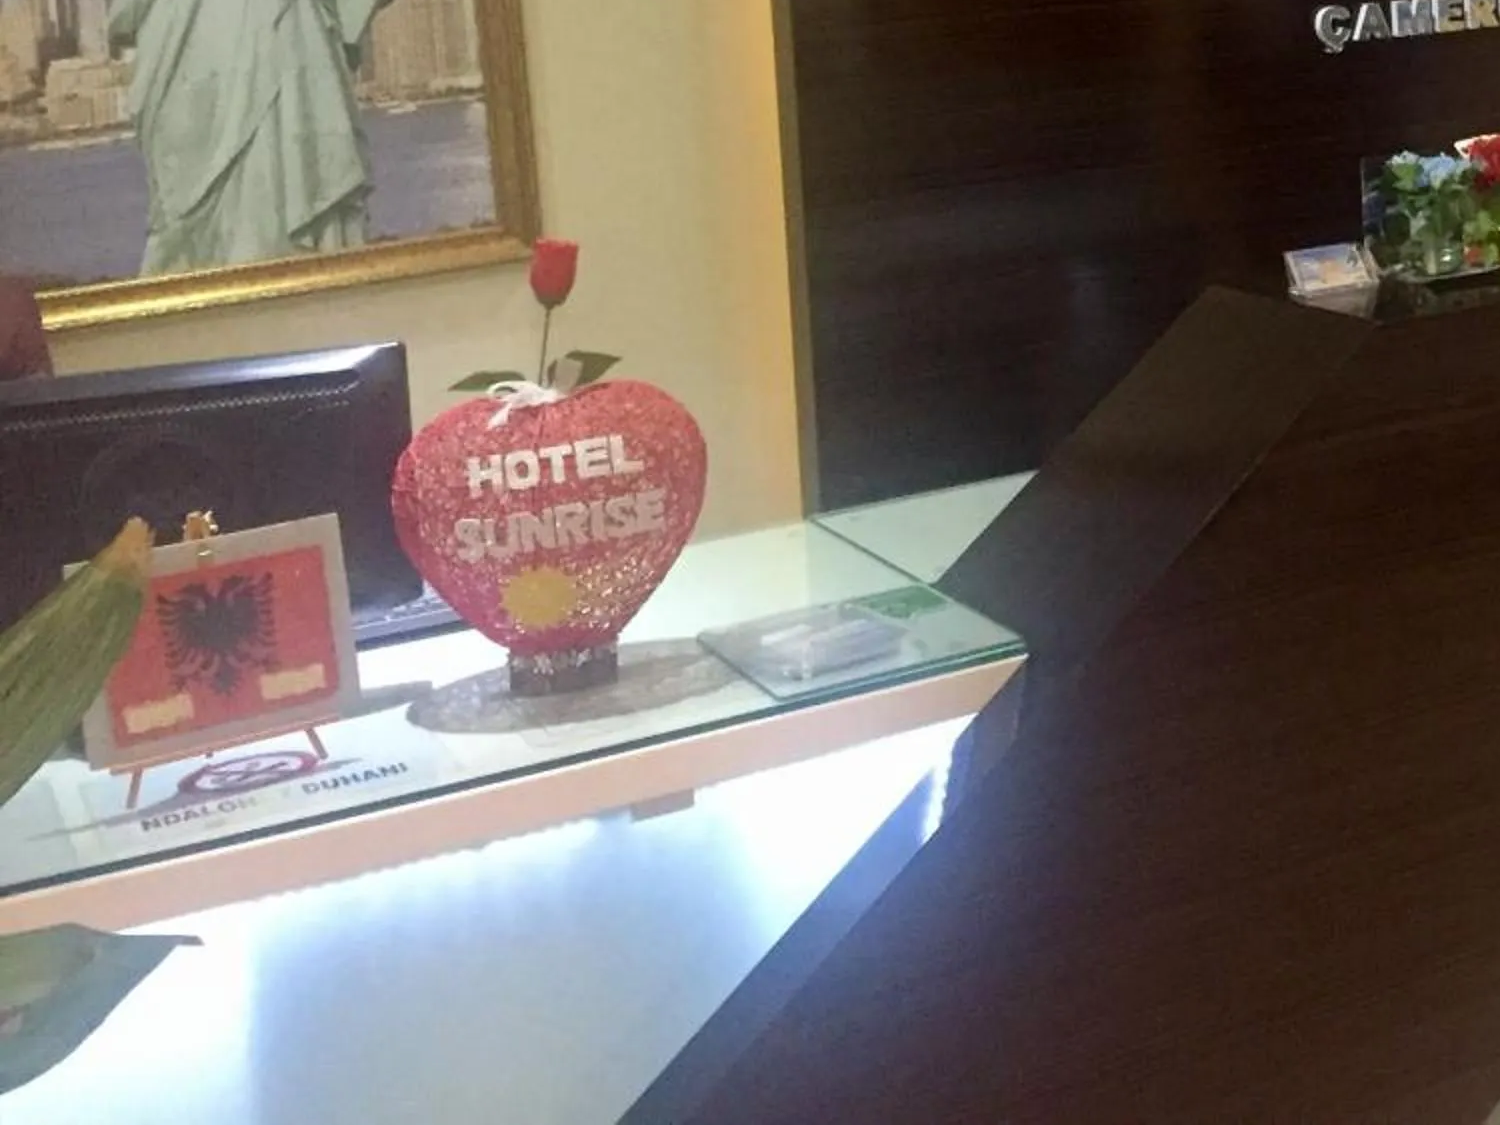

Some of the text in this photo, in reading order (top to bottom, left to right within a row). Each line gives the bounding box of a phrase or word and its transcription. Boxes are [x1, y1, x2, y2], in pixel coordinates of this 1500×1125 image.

[465, 434, 645, 498] HOTEL
[454, 486, 667, 563] SUNRISE
[141, 761, 409, 832] NDALOH DUHANI
